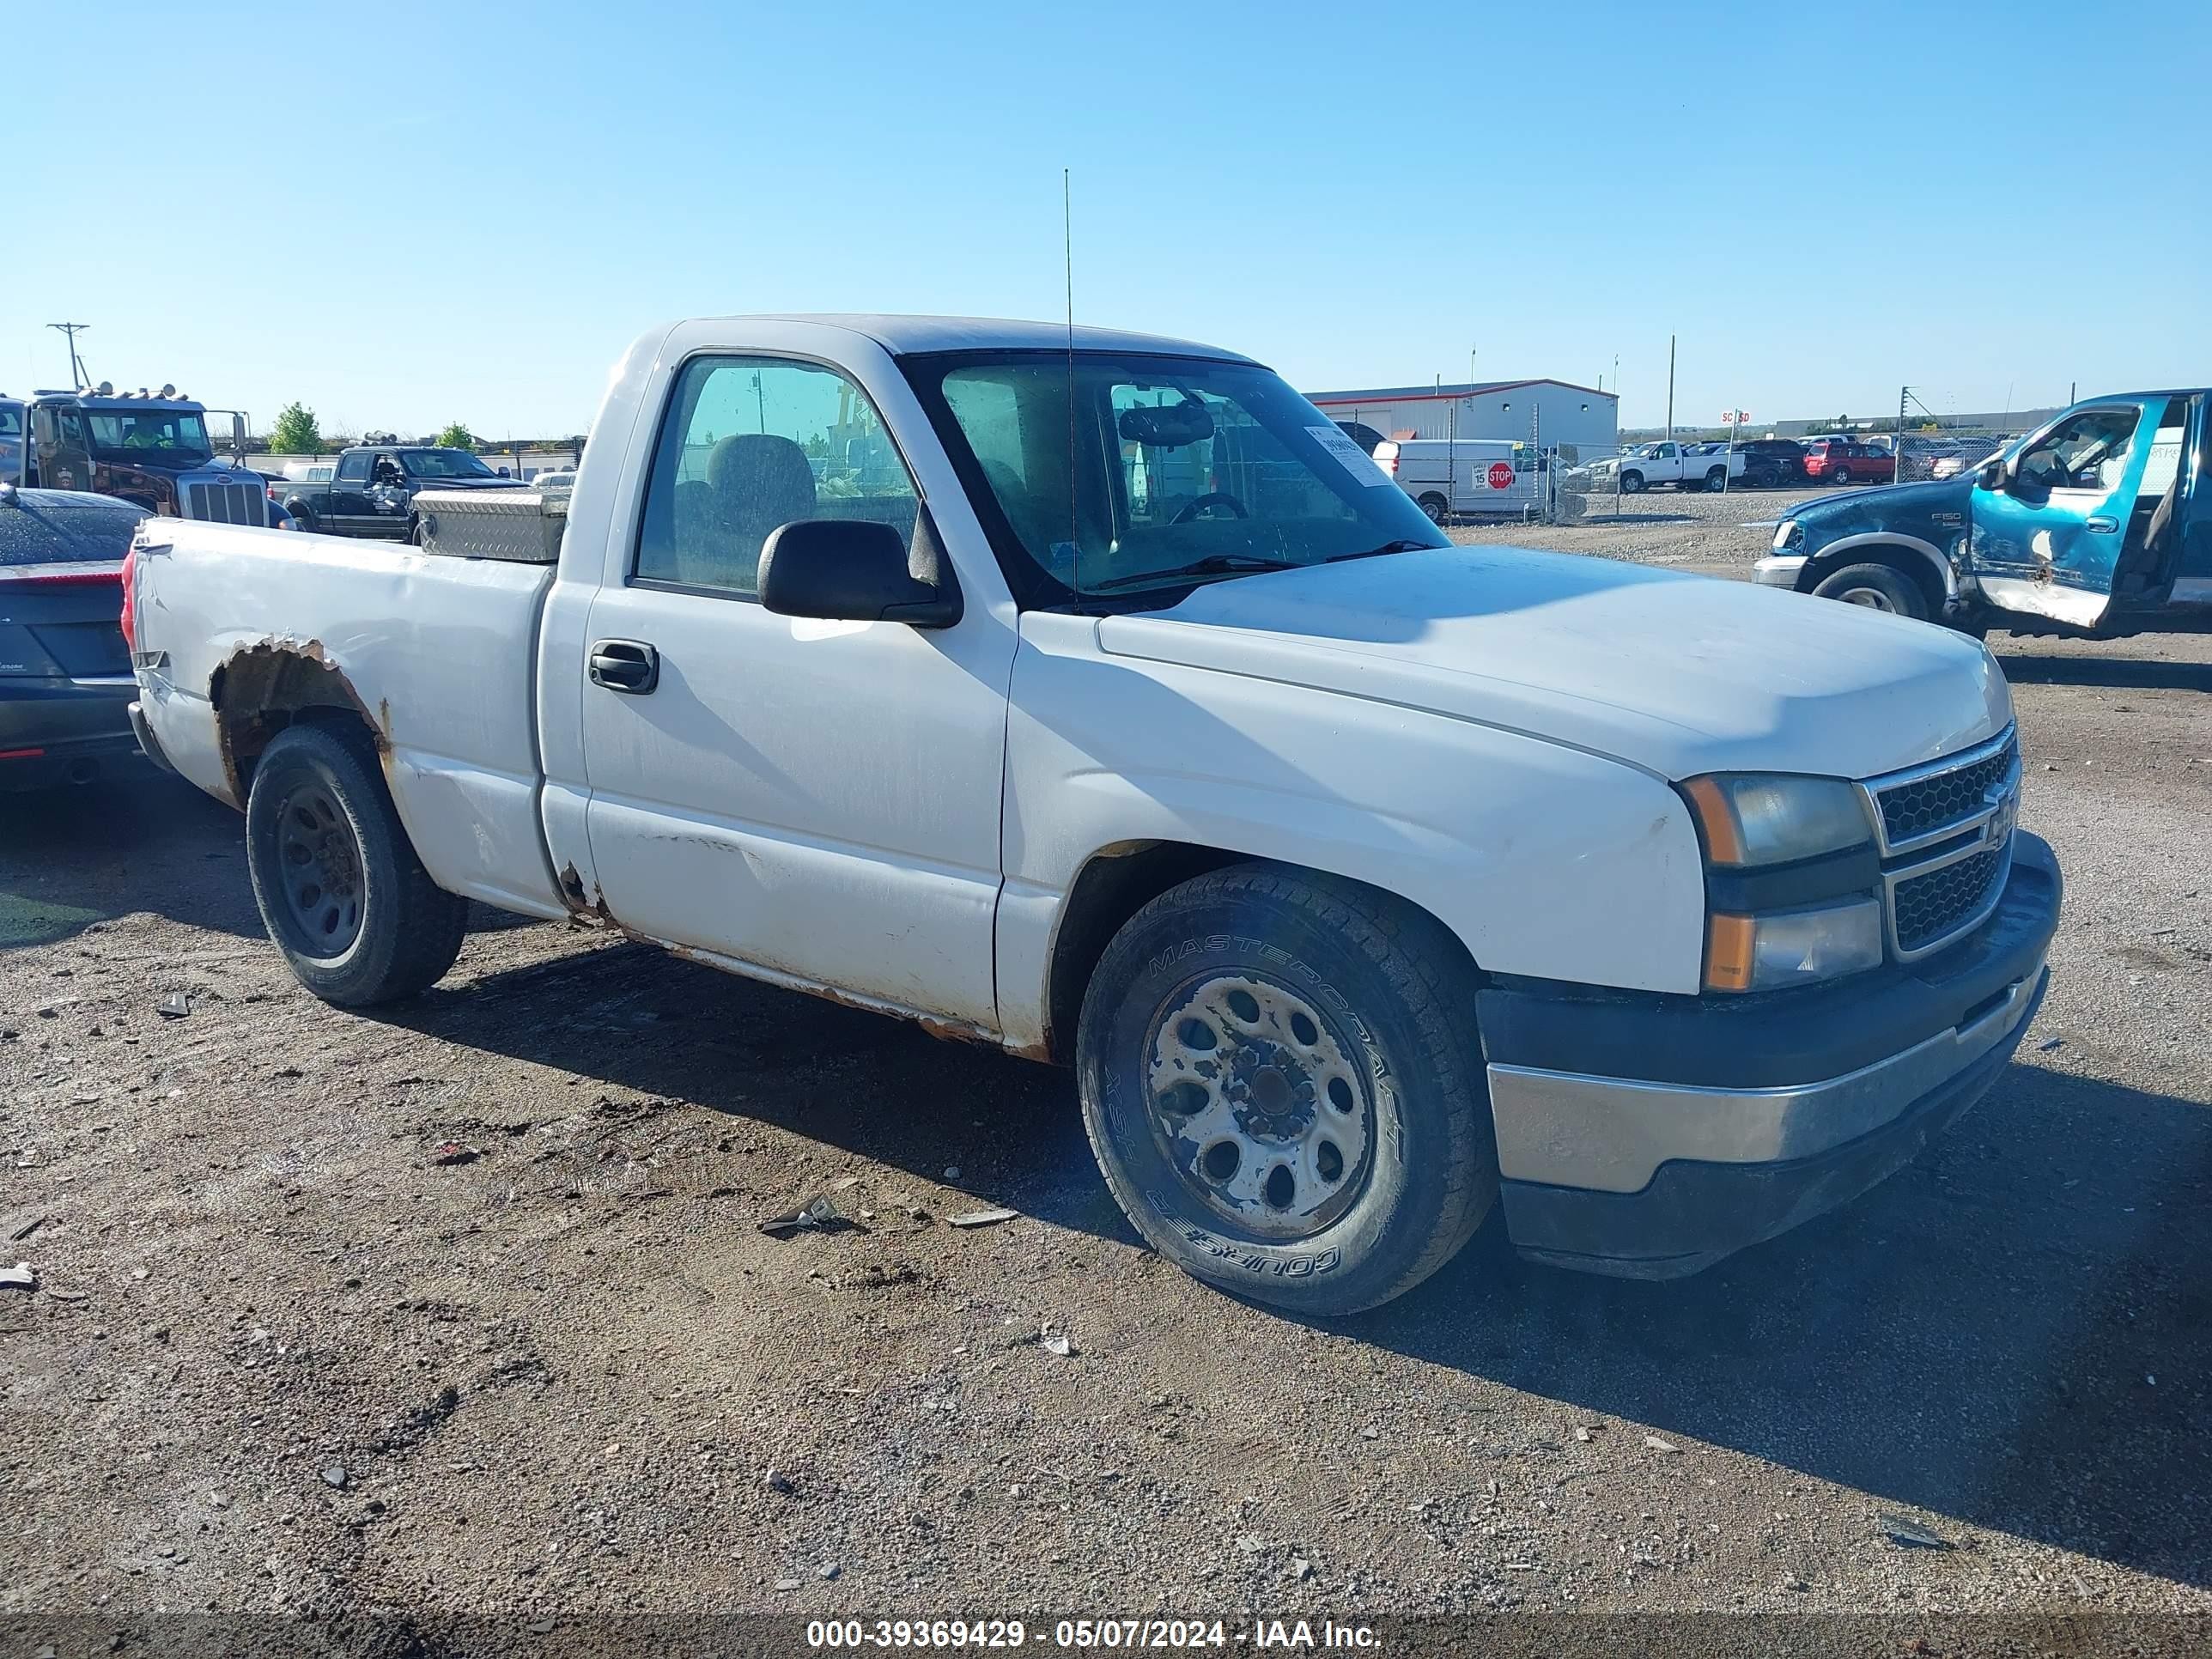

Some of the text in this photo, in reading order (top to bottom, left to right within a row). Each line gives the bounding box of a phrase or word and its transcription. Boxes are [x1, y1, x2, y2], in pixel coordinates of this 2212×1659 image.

[1723, 412, 1733, 422] SC
[1475, 474, 1485, 484] 15
[1489, 471, 1511, 482] STOP
[1147, 933, 1404, 1162] MASTERCRAFT
[1146, 1189, 1341, 1279] COURSER
